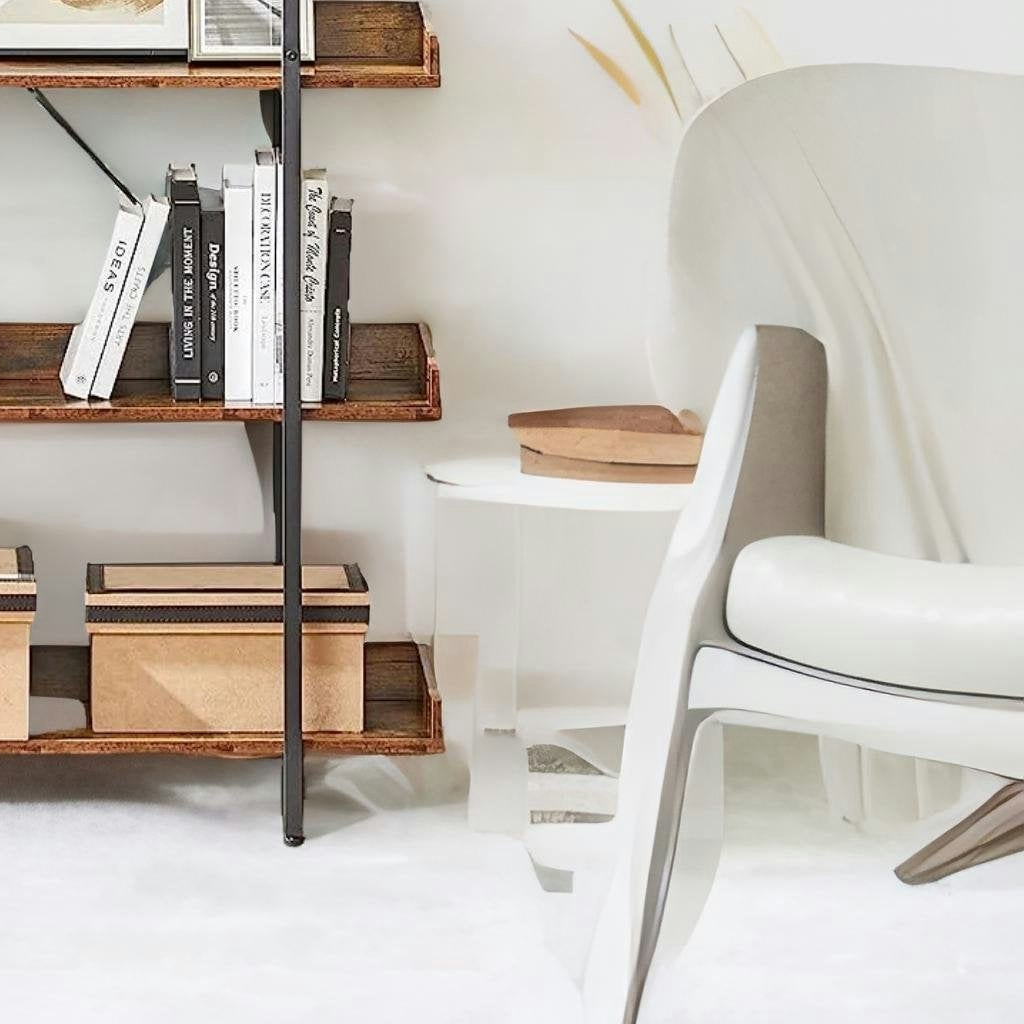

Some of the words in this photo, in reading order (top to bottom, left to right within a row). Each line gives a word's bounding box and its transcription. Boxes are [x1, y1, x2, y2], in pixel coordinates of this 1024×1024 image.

[104, 240, 128, 293] IDEAS
[182, 227, 194, 274] MOMENT
[205, 242, 220, 291] Design
[183, 279, 194, 301] THE
[183, 306, 193, 318] IN
[182, 322, 194, 359] LIVING
